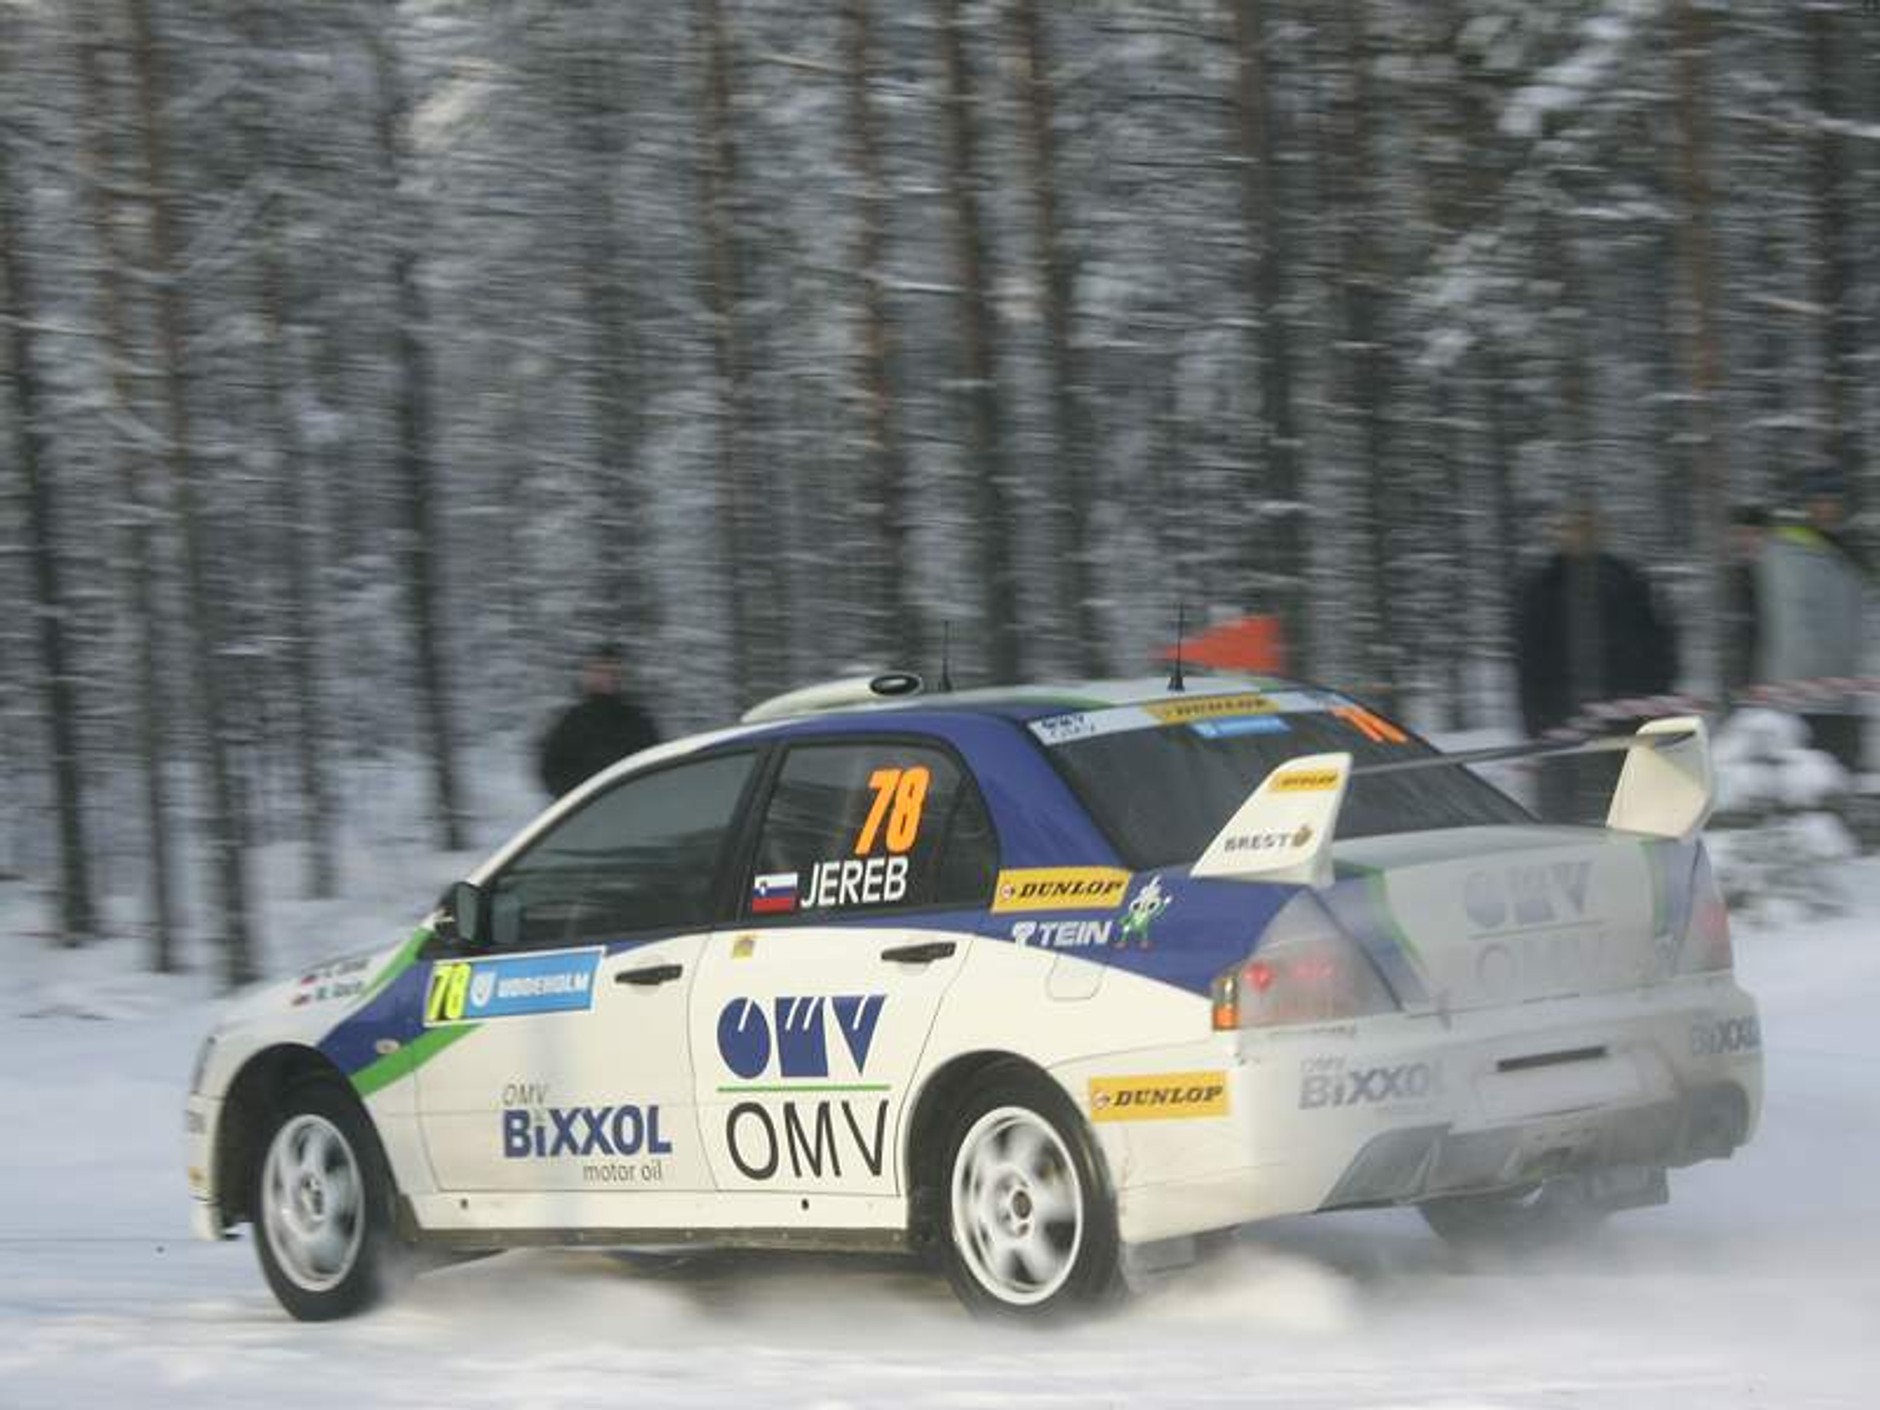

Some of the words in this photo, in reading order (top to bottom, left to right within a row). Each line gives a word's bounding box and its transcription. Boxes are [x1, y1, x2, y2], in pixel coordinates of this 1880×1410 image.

[853, 766, 931, 854] 78
[1224, 834, 1291, 852] BREST
[801, 857, 909, 908] JEREB
[1019, 880, 1125, 898] DUNLOP
[1039, 920, 1113, 946] TEIN
[428, 962, 471, 1020] 78
[716, 994, 888, 1079] OMV
[503, 1084, 548, 1106] OMV
[1113, 1085, 1224, 1109] DUNLOP
[504, 1104, 673, 1158] BiXXOL
[725, 1100, 890, 1181] OMV
[583, 1161, 636, 1182] motor
[641, 1159, 662, 1181] oil
